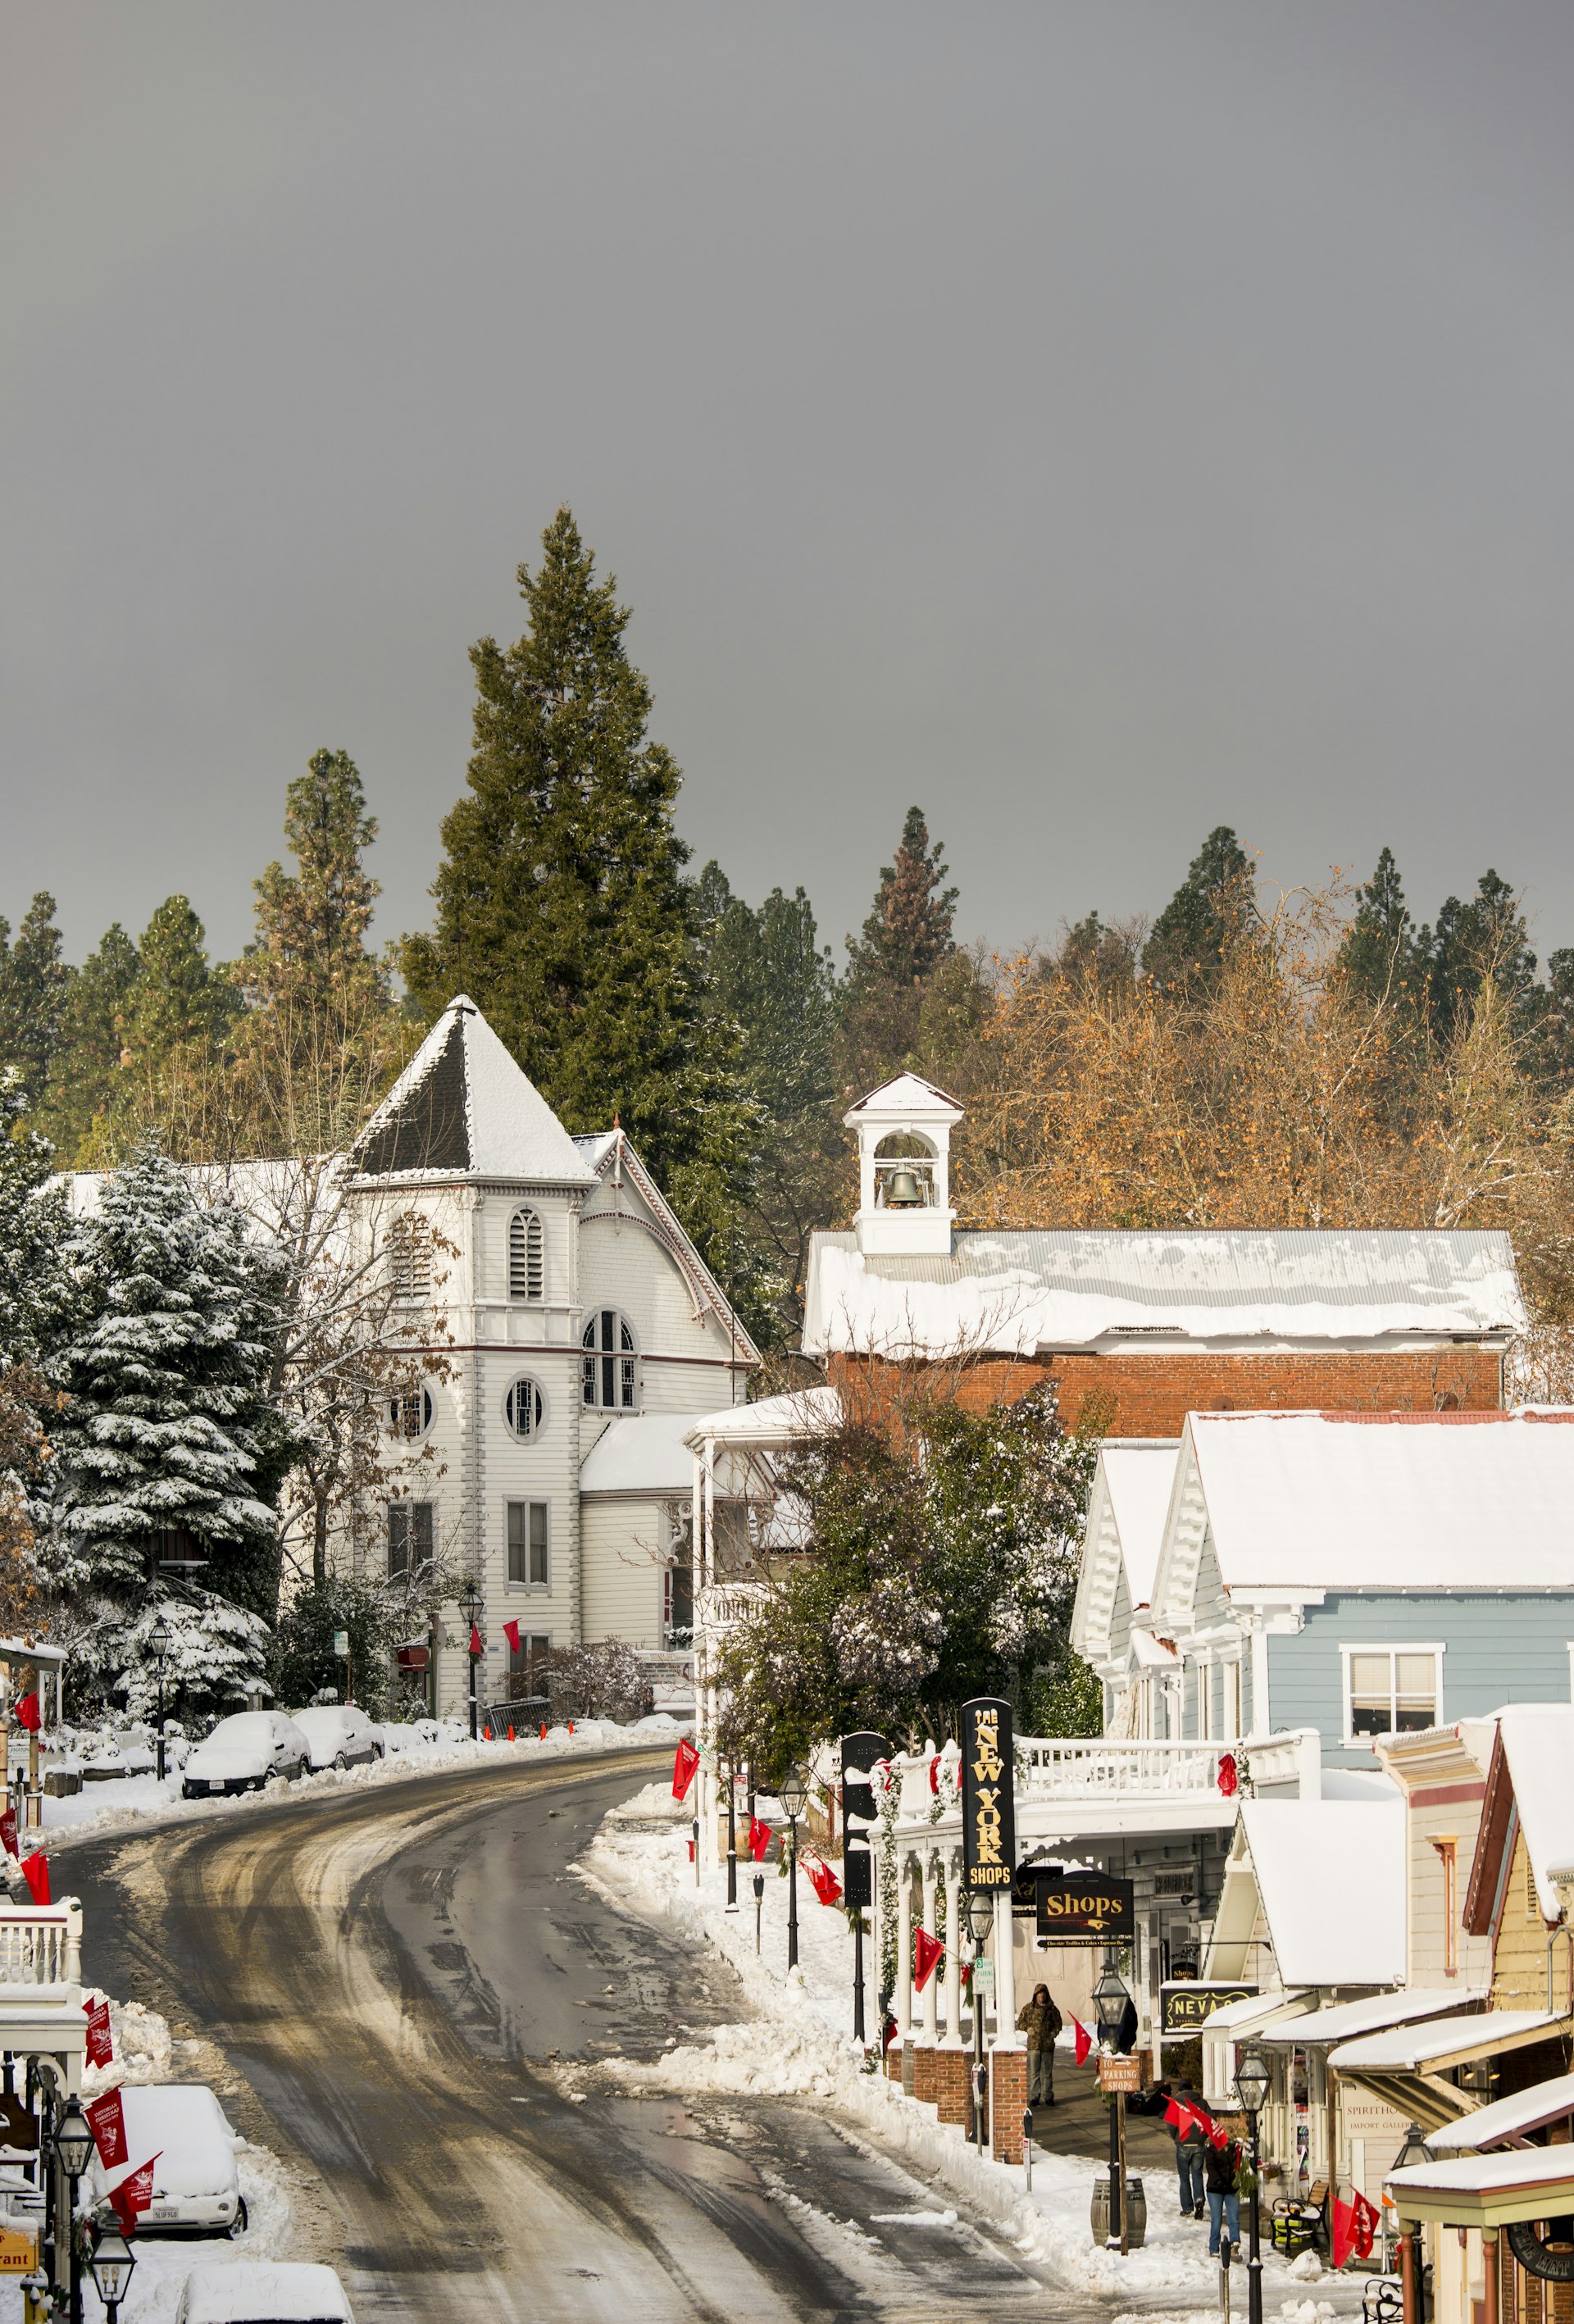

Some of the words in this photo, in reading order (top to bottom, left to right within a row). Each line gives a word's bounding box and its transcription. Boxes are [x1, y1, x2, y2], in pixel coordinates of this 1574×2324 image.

[975, 1709, 999, 1724] THE
[971, 1723, 1005, 1781] NEW
[975, 1788, 1003, 1863] YORK
[970, 1867, 1011, 1885] SHOPS
[1047, 1893, 1123, 1917] Shops
[977, 1959, 982, 1967] 3
[1103, 2059, 1112, 2068] TO
[1103, 2070, 1137, 2080] PARKING
[1108, 2081, 1133, 2090] SHOPS
[94, 2102, 118, 2117] VICTORIAN
